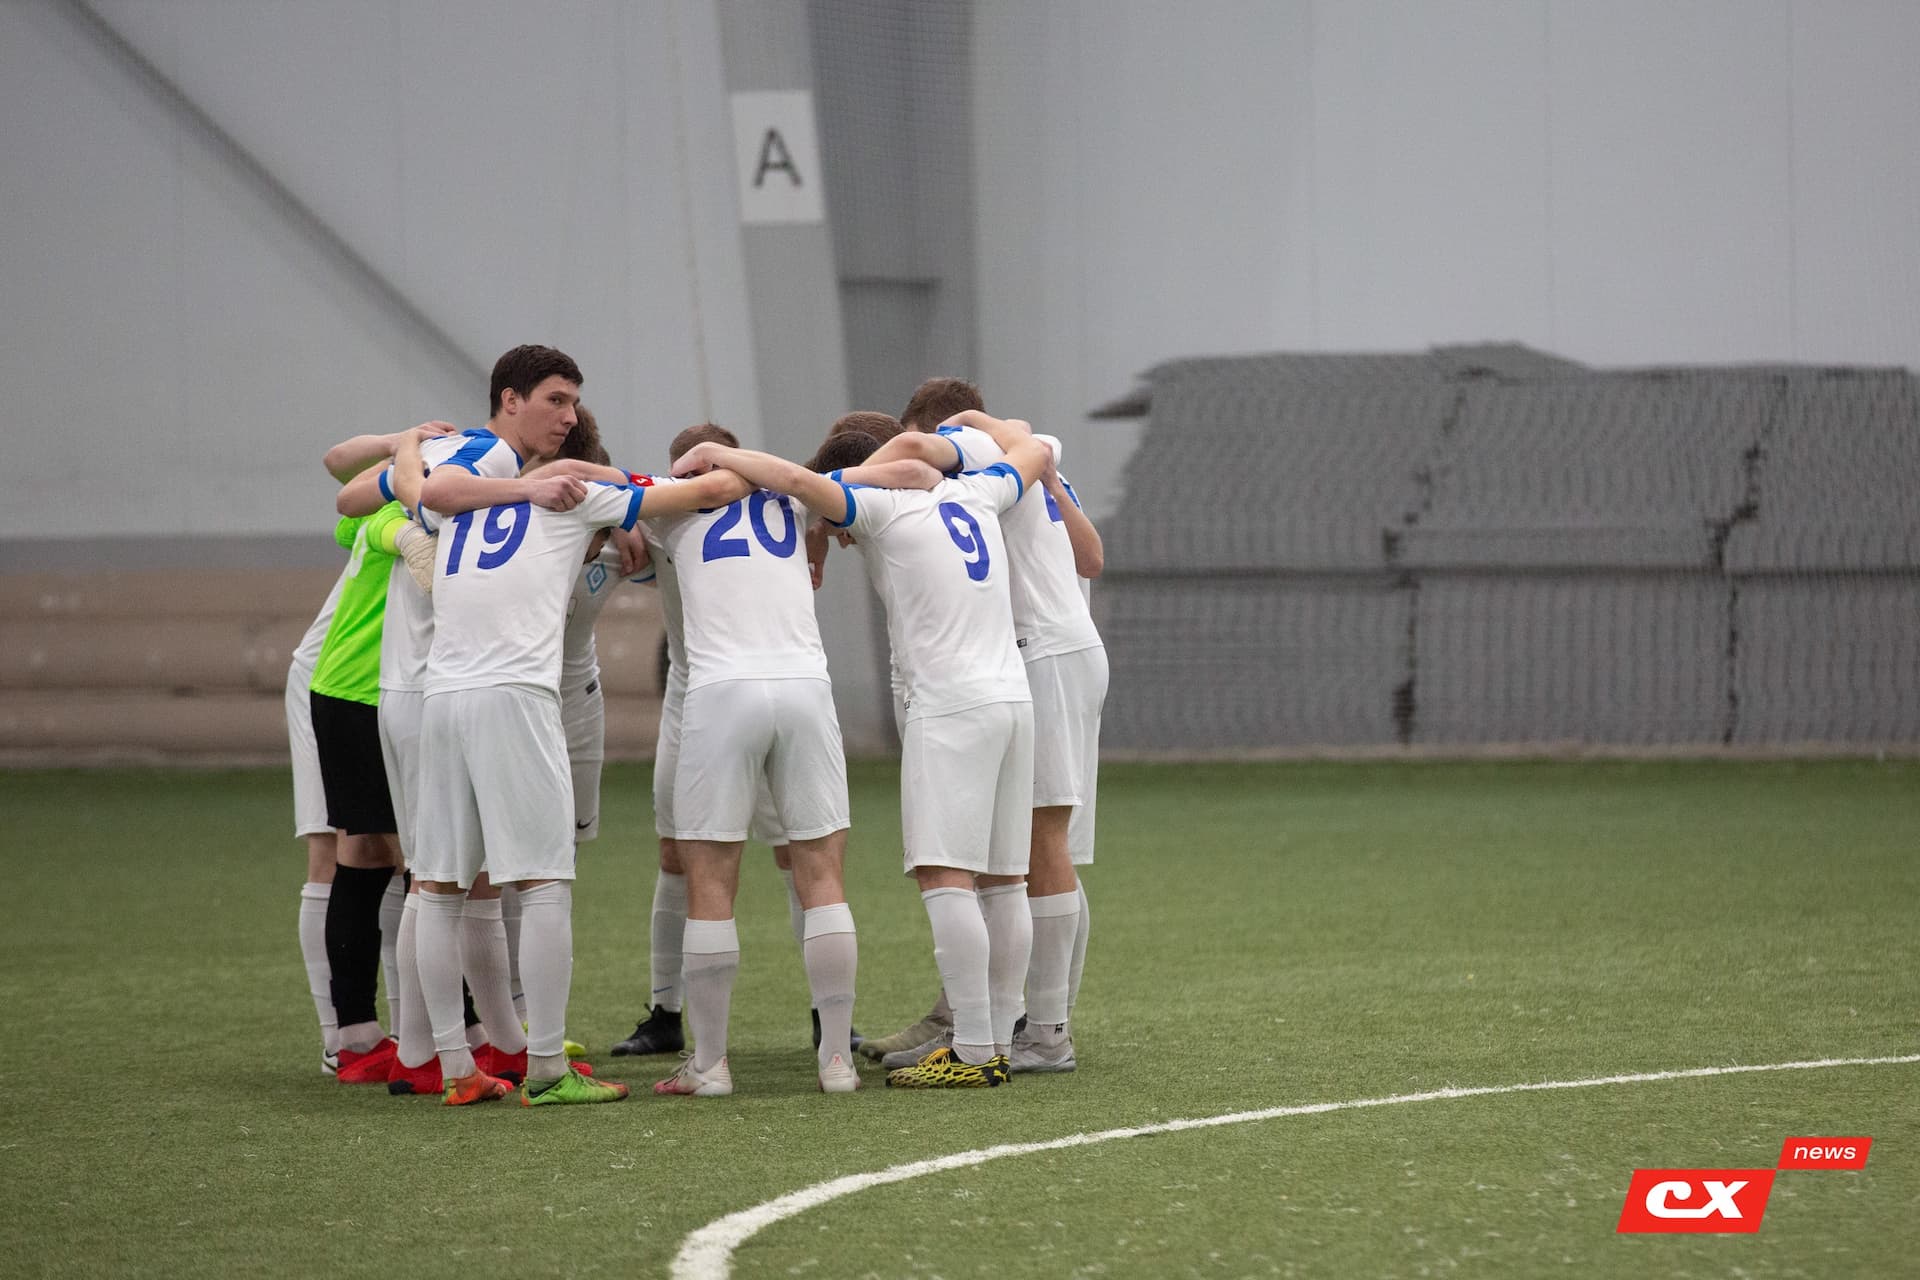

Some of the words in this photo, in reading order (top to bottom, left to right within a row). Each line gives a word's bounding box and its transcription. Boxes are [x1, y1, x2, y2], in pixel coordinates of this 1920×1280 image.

[754, 127, 803, 189] A
[445, 501, 532, 576] 19
[702, 490, 797, 563] 20
[938, 502, 990, 581] 9
